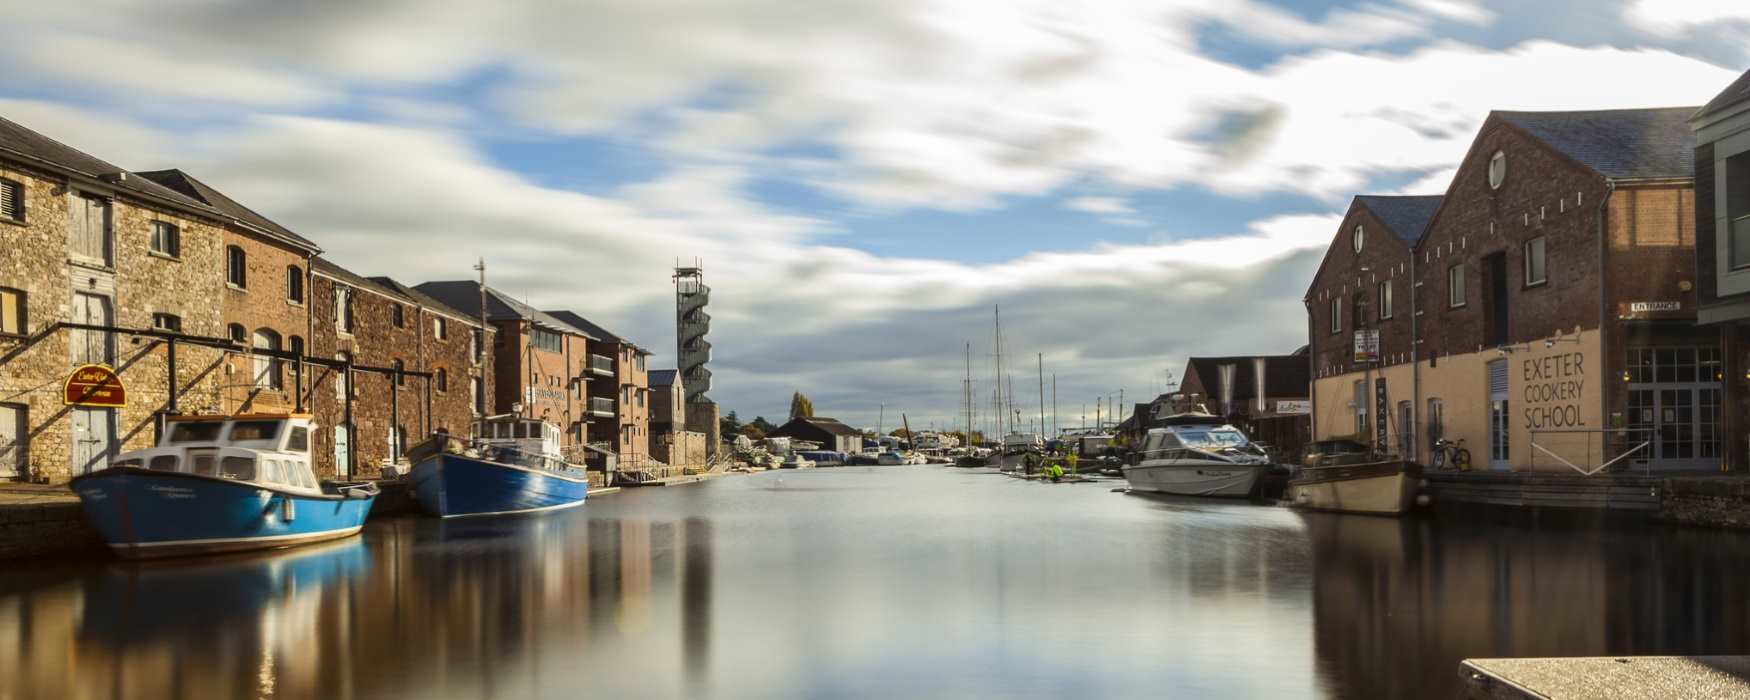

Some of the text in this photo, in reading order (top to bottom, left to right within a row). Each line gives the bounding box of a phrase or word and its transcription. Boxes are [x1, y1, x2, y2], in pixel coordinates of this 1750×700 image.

[1524, 352, 1584, 381] EXETER
[1524, 380, 1584, 403] COOKERY
[1525, 404, 1584, 429] SCHOOL
